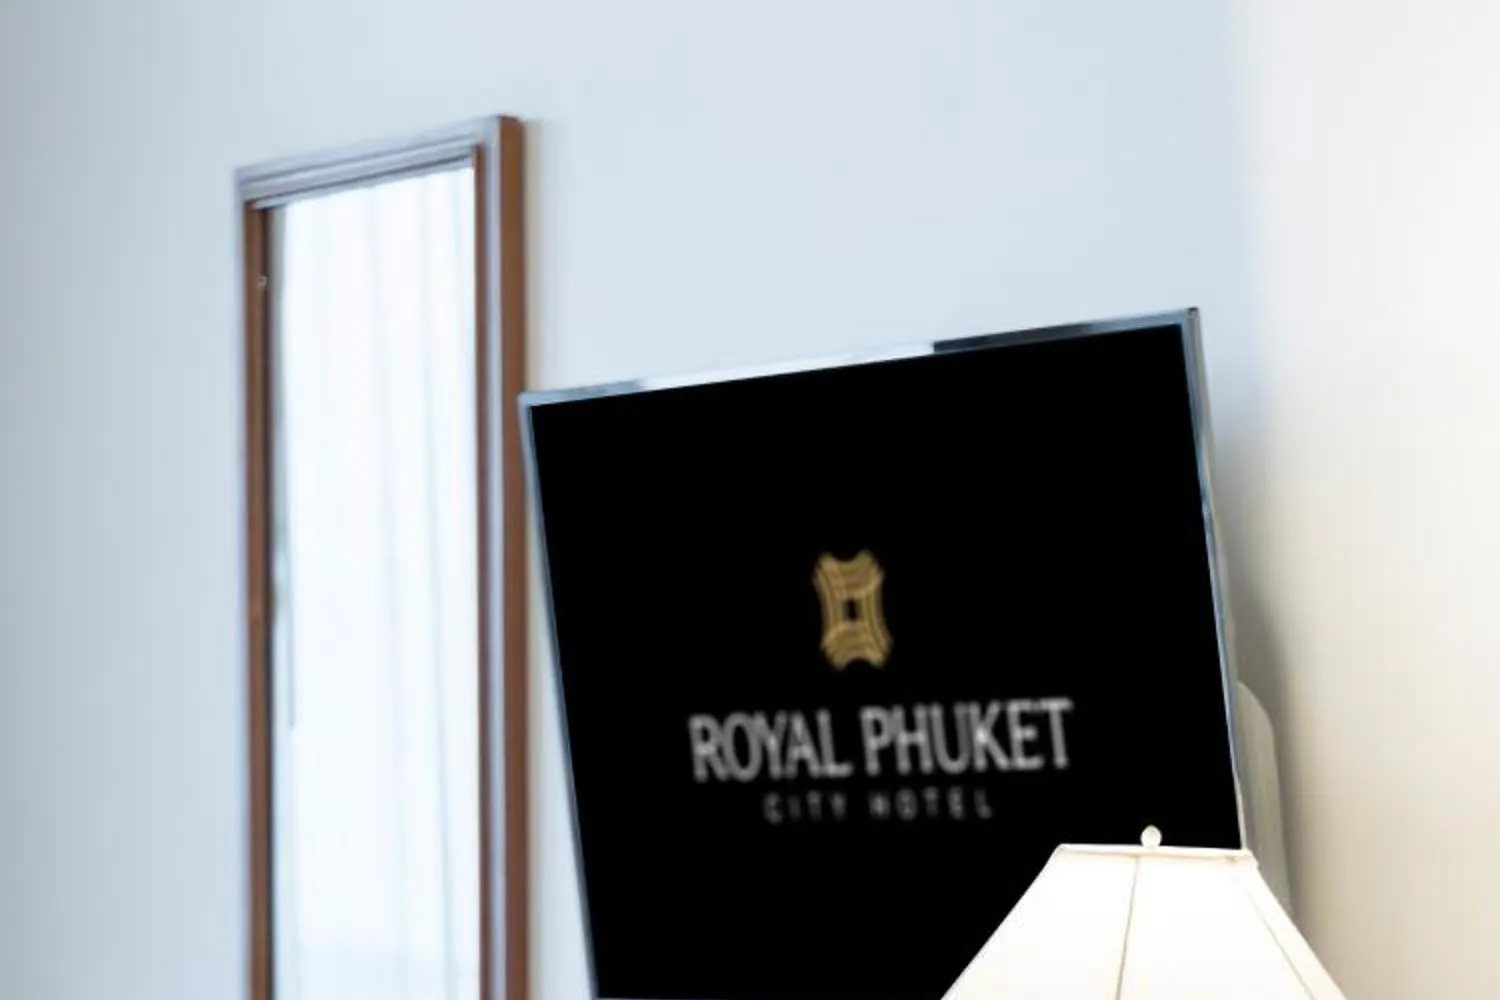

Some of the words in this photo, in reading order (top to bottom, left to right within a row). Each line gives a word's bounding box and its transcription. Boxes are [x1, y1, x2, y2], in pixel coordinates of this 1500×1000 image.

[688, 708, 854, 782] ROYAL
[859, 697, 1074, 777] PHUKET
[763, 791, 847, 824] CITY
[868, 786, 993, 821] HOTEL
